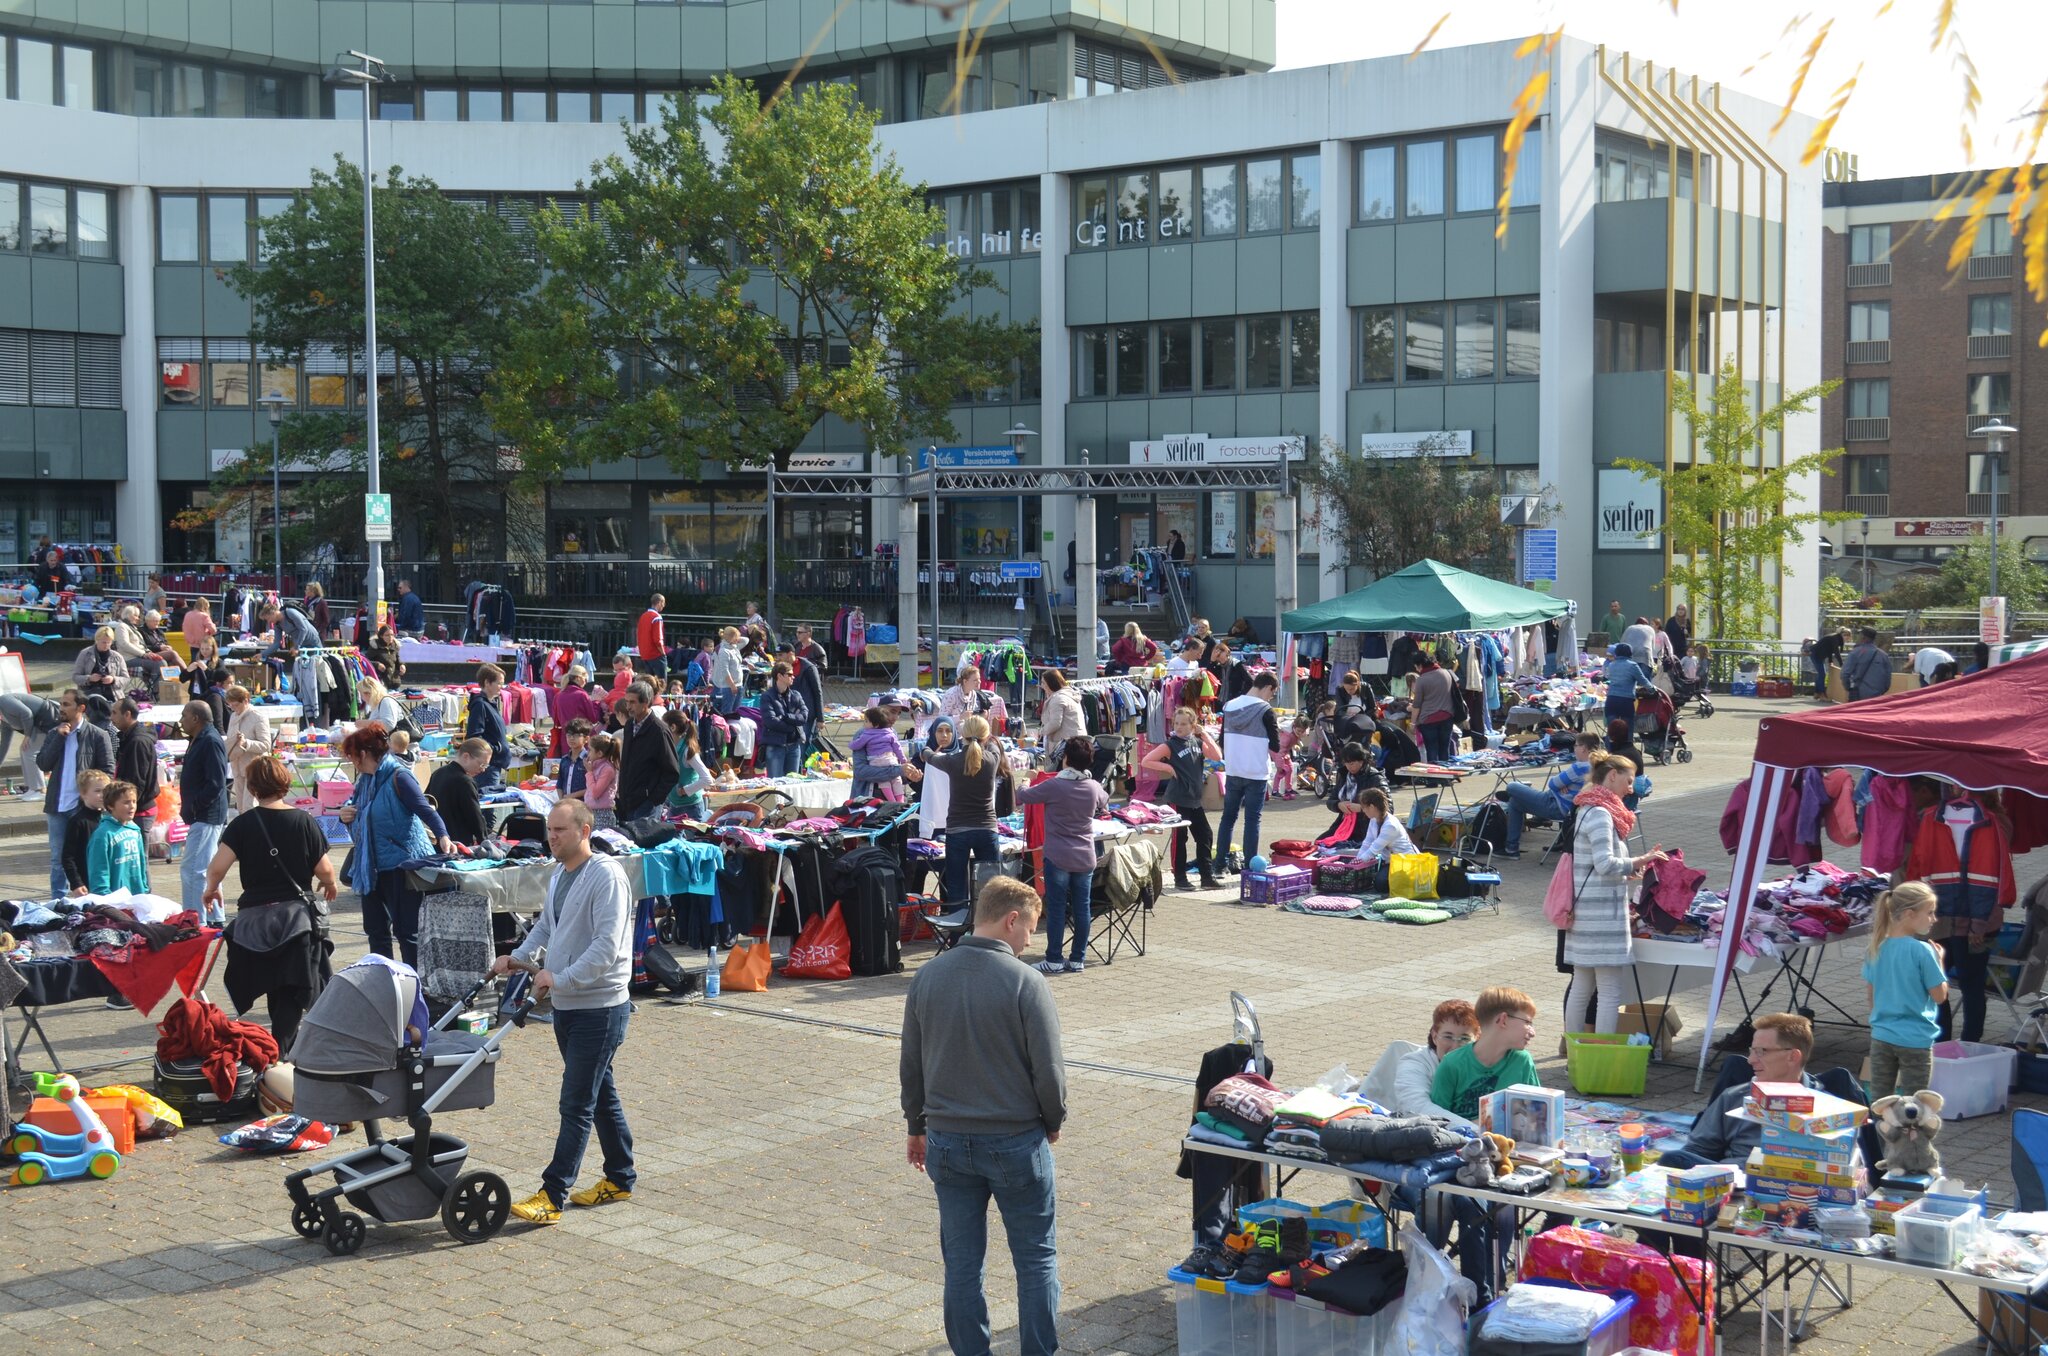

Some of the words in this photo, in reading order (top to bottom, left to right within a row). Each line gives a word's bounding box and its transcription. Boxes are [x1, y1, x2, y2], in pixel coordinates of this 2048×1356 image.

[1076, 217, 1185, 245] Center
[1166, 436, 1204, 462] seifen
[1220, 445, 1295, 461] fotostudo
[963, 457, 1010, 466] Bausparkasse
[1603, 501, 1653, 532] seifen
[123, 838, 139, 855] 98
